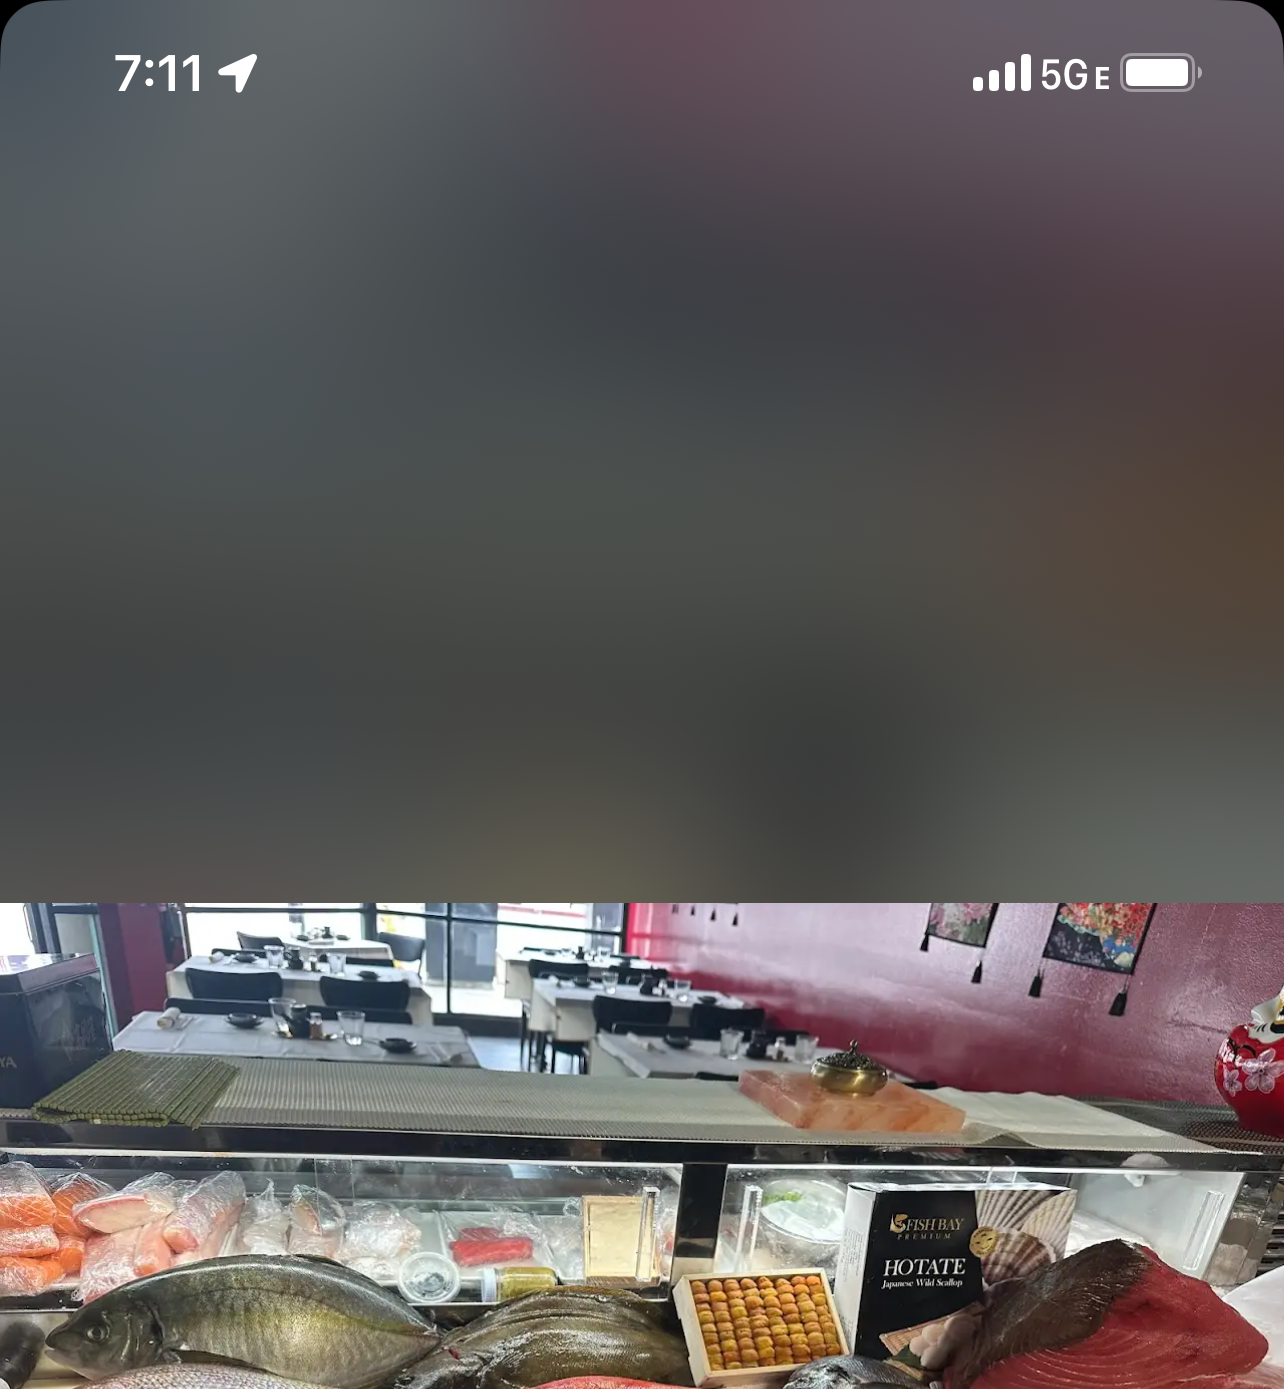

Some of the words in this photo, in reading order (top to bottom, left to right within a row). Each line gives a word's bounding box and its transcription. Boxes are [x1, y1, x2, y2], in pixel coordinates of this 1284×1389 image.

[906, 1219, 936, 1231] FISH
[937, 1218, 963, 1231] BAY
[883, 1258, 966, 1276] HOTATE
[881, 1280, 914, 1289] Japanese
[916, 1279, 935, 1287] Wild
[936, 1278, 963, 1288] Scallop
